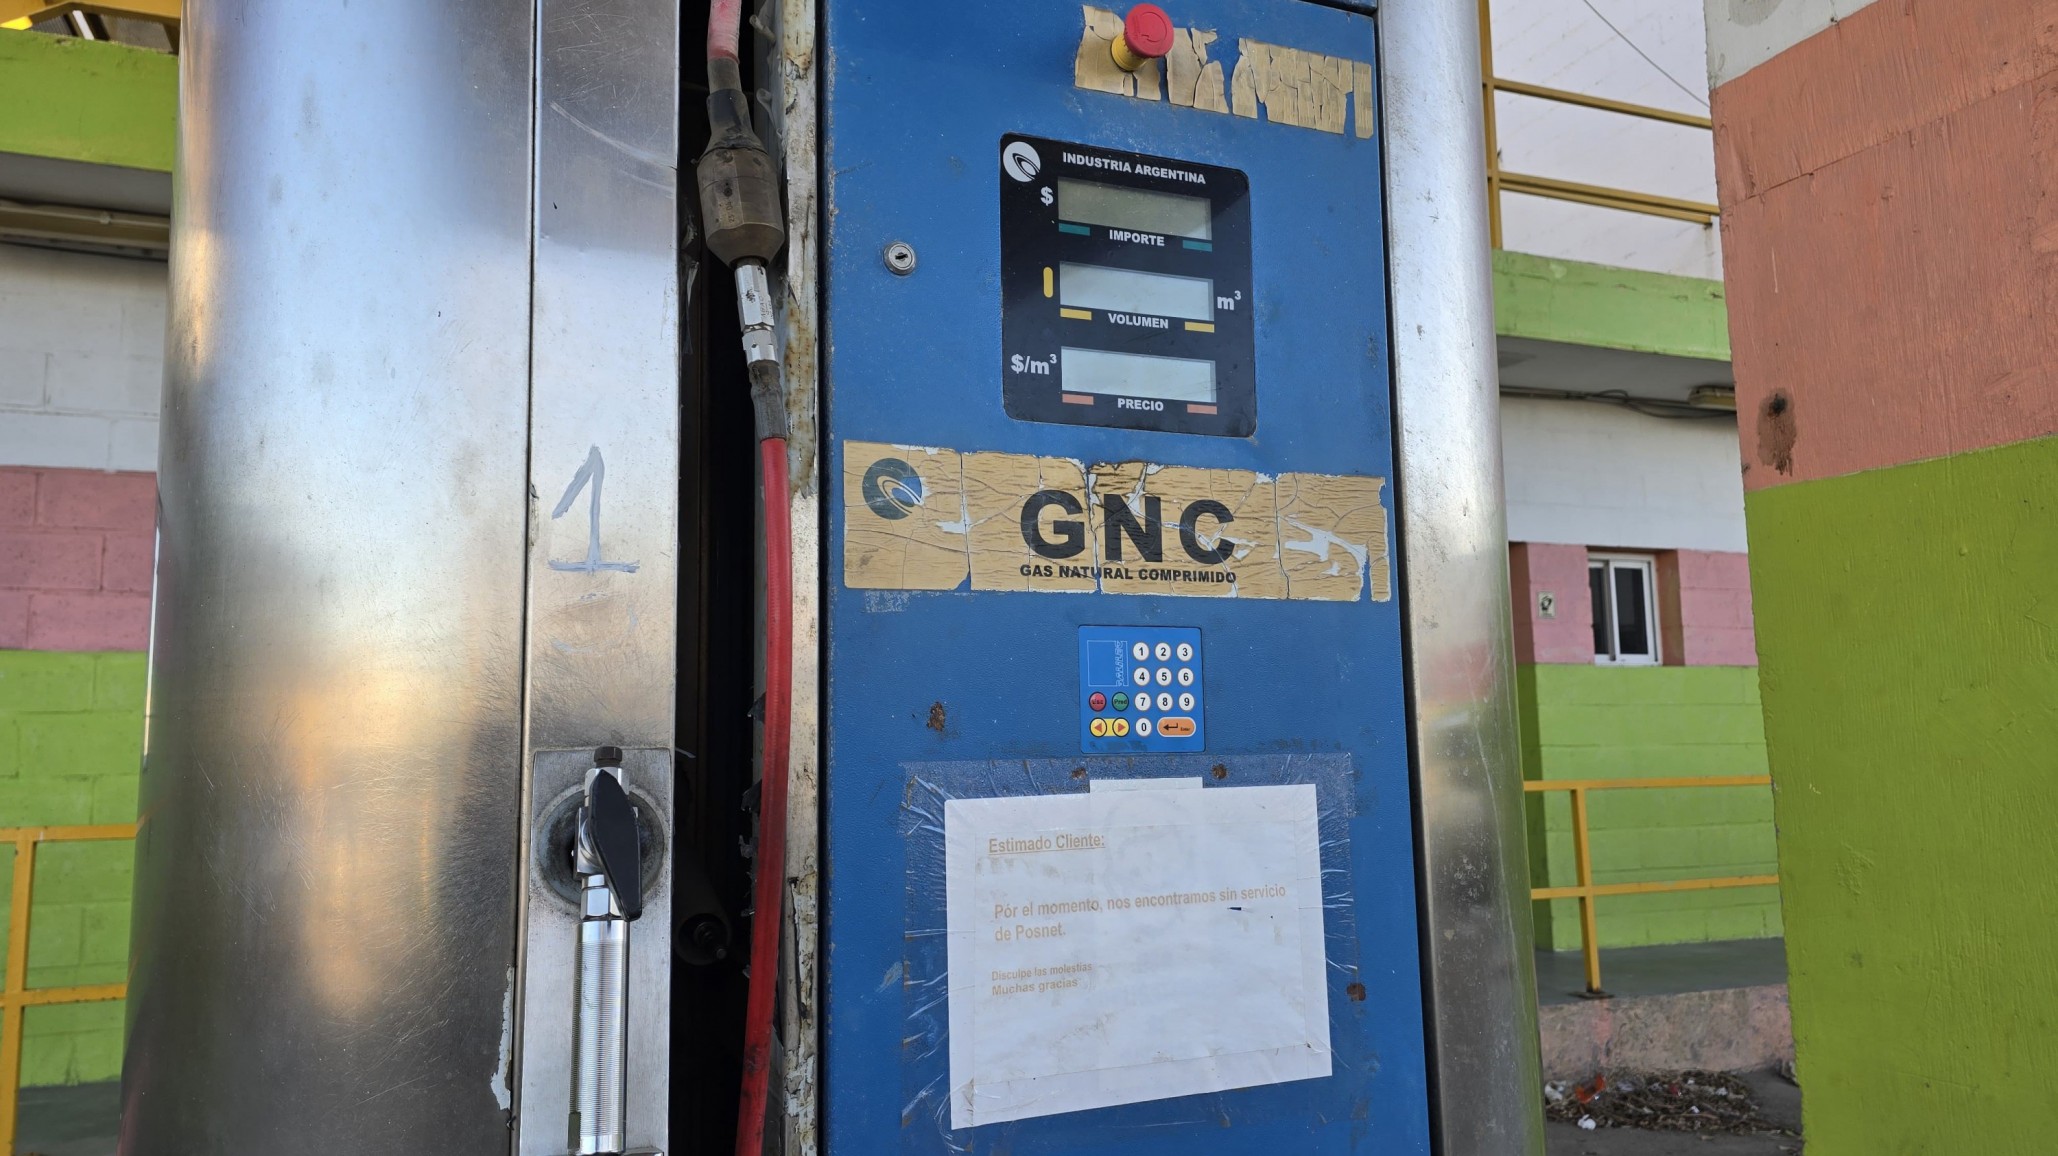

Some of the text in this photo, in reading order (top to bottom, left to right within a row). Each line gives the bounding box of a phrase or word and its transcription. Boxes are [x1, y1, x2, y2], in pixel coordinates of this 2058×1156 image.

[1062, 152, 1206, 184] INDUSTRIA ARGENTINA
[1041, 186, 1054, 206] $
[1109, 229, 1165, 246] IMPORTE
[1107, 312, 1169, 330] VOLUMEN
[1117, 398, 1164, 412] PRECIO
[547, 443, 640, 576] 1
[1020, 489, 1235, 565] GNC
[1020, 564, 1237, 584] GAS NATURAL COMPRIMIDO
[1139, 647, 1188, 657] 1 2 3
[1139, 672, 1189, 681] 4 5 6
[1140, 697, 1146, 706] 7
[1162, 697, 1168, 706] 8
[1184, 697, 1190, 706] 9
[1141, 723, 1147, 731] 0
[988, 833, 1105, 855] Estimado Cliente:
[1022, 902, 1034, 917] el
[1038, 898, 1103, 916] momento,
[1107, 897, 1131, 910] nos
[1135, 890, 1216, 908] encontramos
[1219, 887, 1237, 902] sin
[1240, 883, 1286, 900] servicio
[995, 922, 1066, 942] de Posnet.
[991, 962, 1093, 981] Disculpe las molestias
[992, 977, 1078, 996] Muchas gracias
